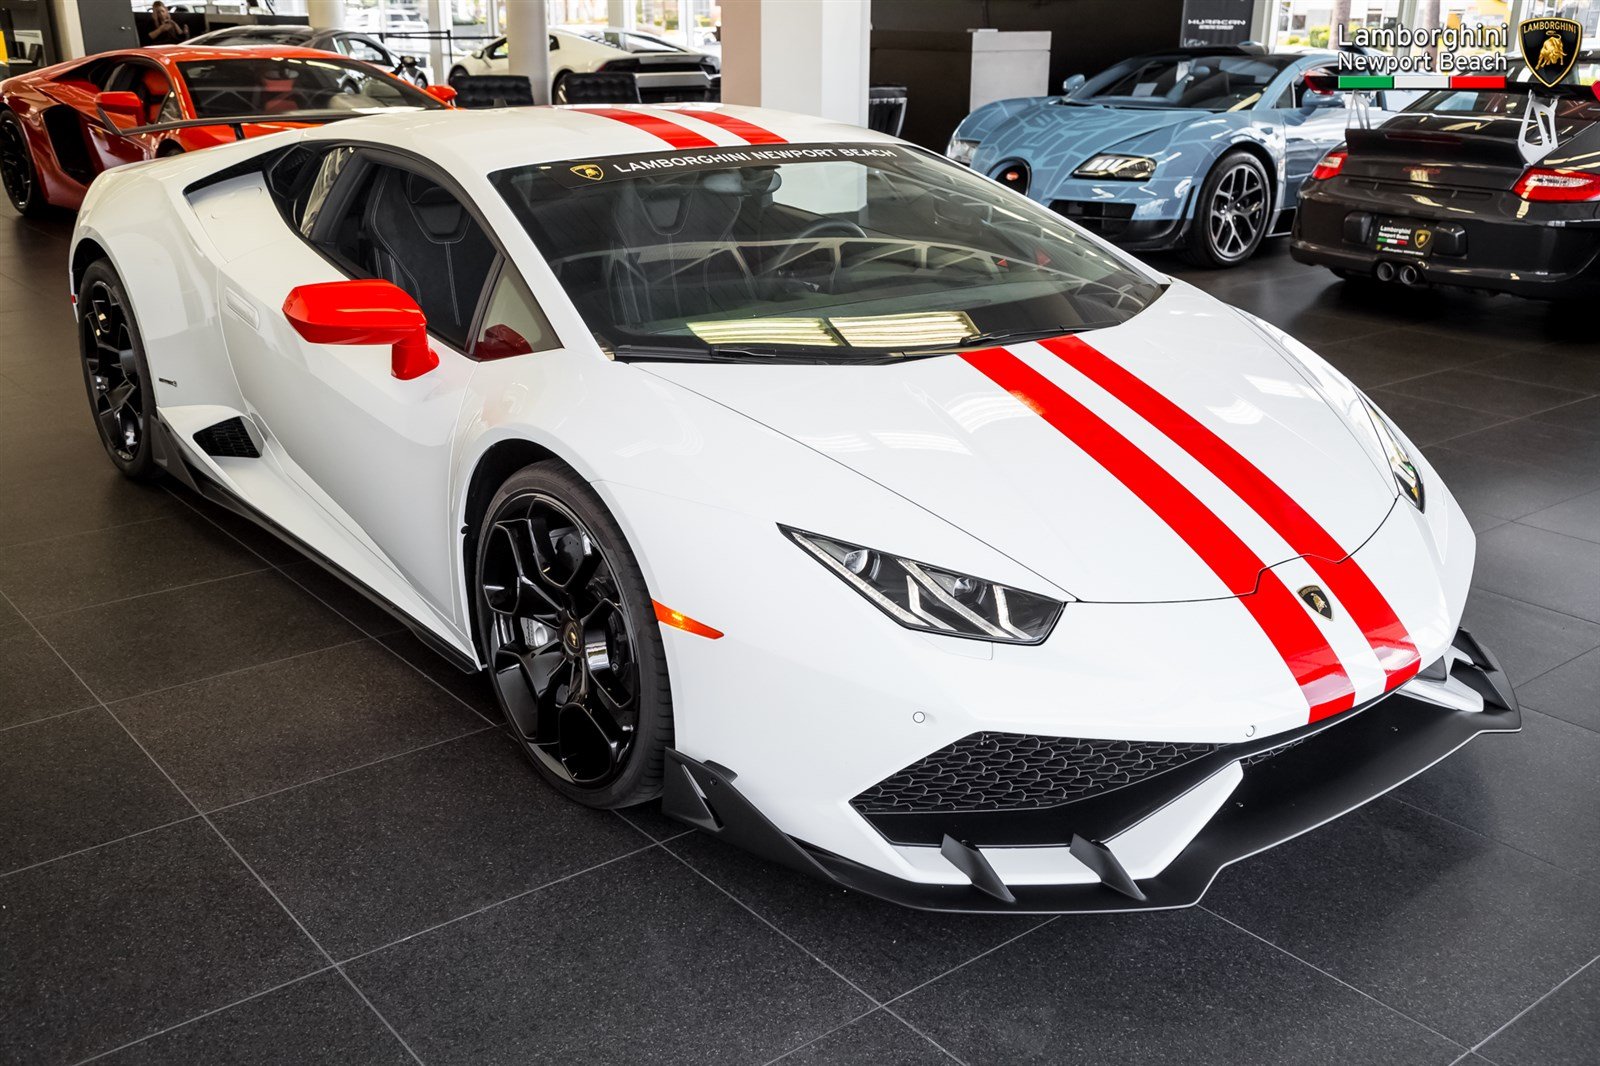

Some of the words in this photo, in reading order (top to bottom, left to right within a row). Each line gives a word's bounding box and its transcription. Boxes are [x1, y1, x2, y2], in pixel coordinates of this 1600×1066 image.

[613, 153, 752, 173] LAMBORGHINI
[751, 149, 838, 160] NEWPORT
[837, 149, 898, 158] BEACH
